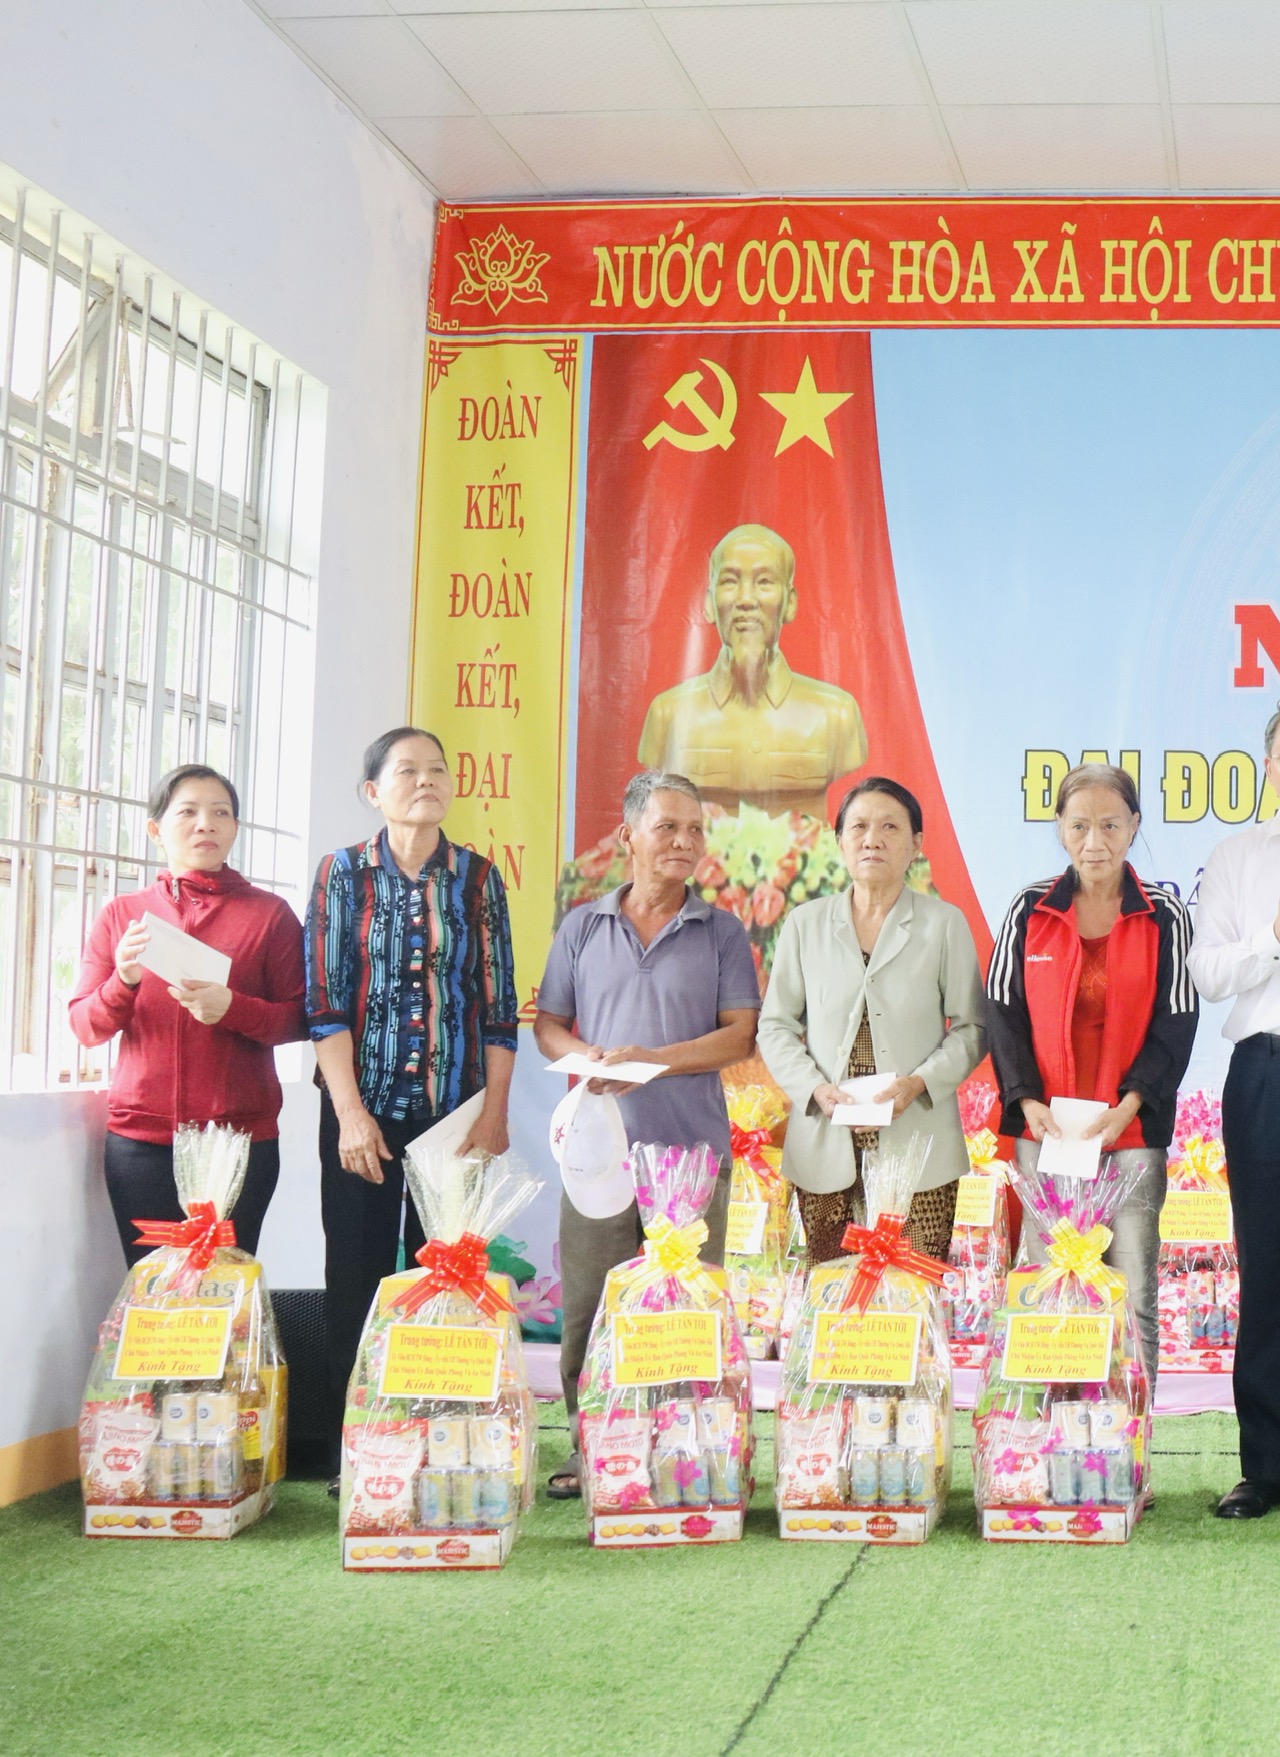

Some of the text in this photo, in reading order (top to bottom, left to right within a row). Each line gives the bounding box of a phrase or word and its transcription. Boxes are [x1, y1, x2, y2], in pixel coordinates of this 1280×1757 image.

[590, 220, 725, 308] NƯỚC
[736, 216, 874, 322] CỘNG
[889, 215, 996, 304] HÒA
[1012, 220, 1084, 304] XÃ
[1100, 215, 1192, 322] HỘI
[457, 379, 542, 442] ĐOÀN
[463, 463, 525, 537] KẾT,
[448, 558, 533, 620] ĐOÀN
[454, 643, 522, 719] KẾT,
[455, 752, 513, 812] ĐẠI
[867, 1523, 896, 1531] MAJESTIC
